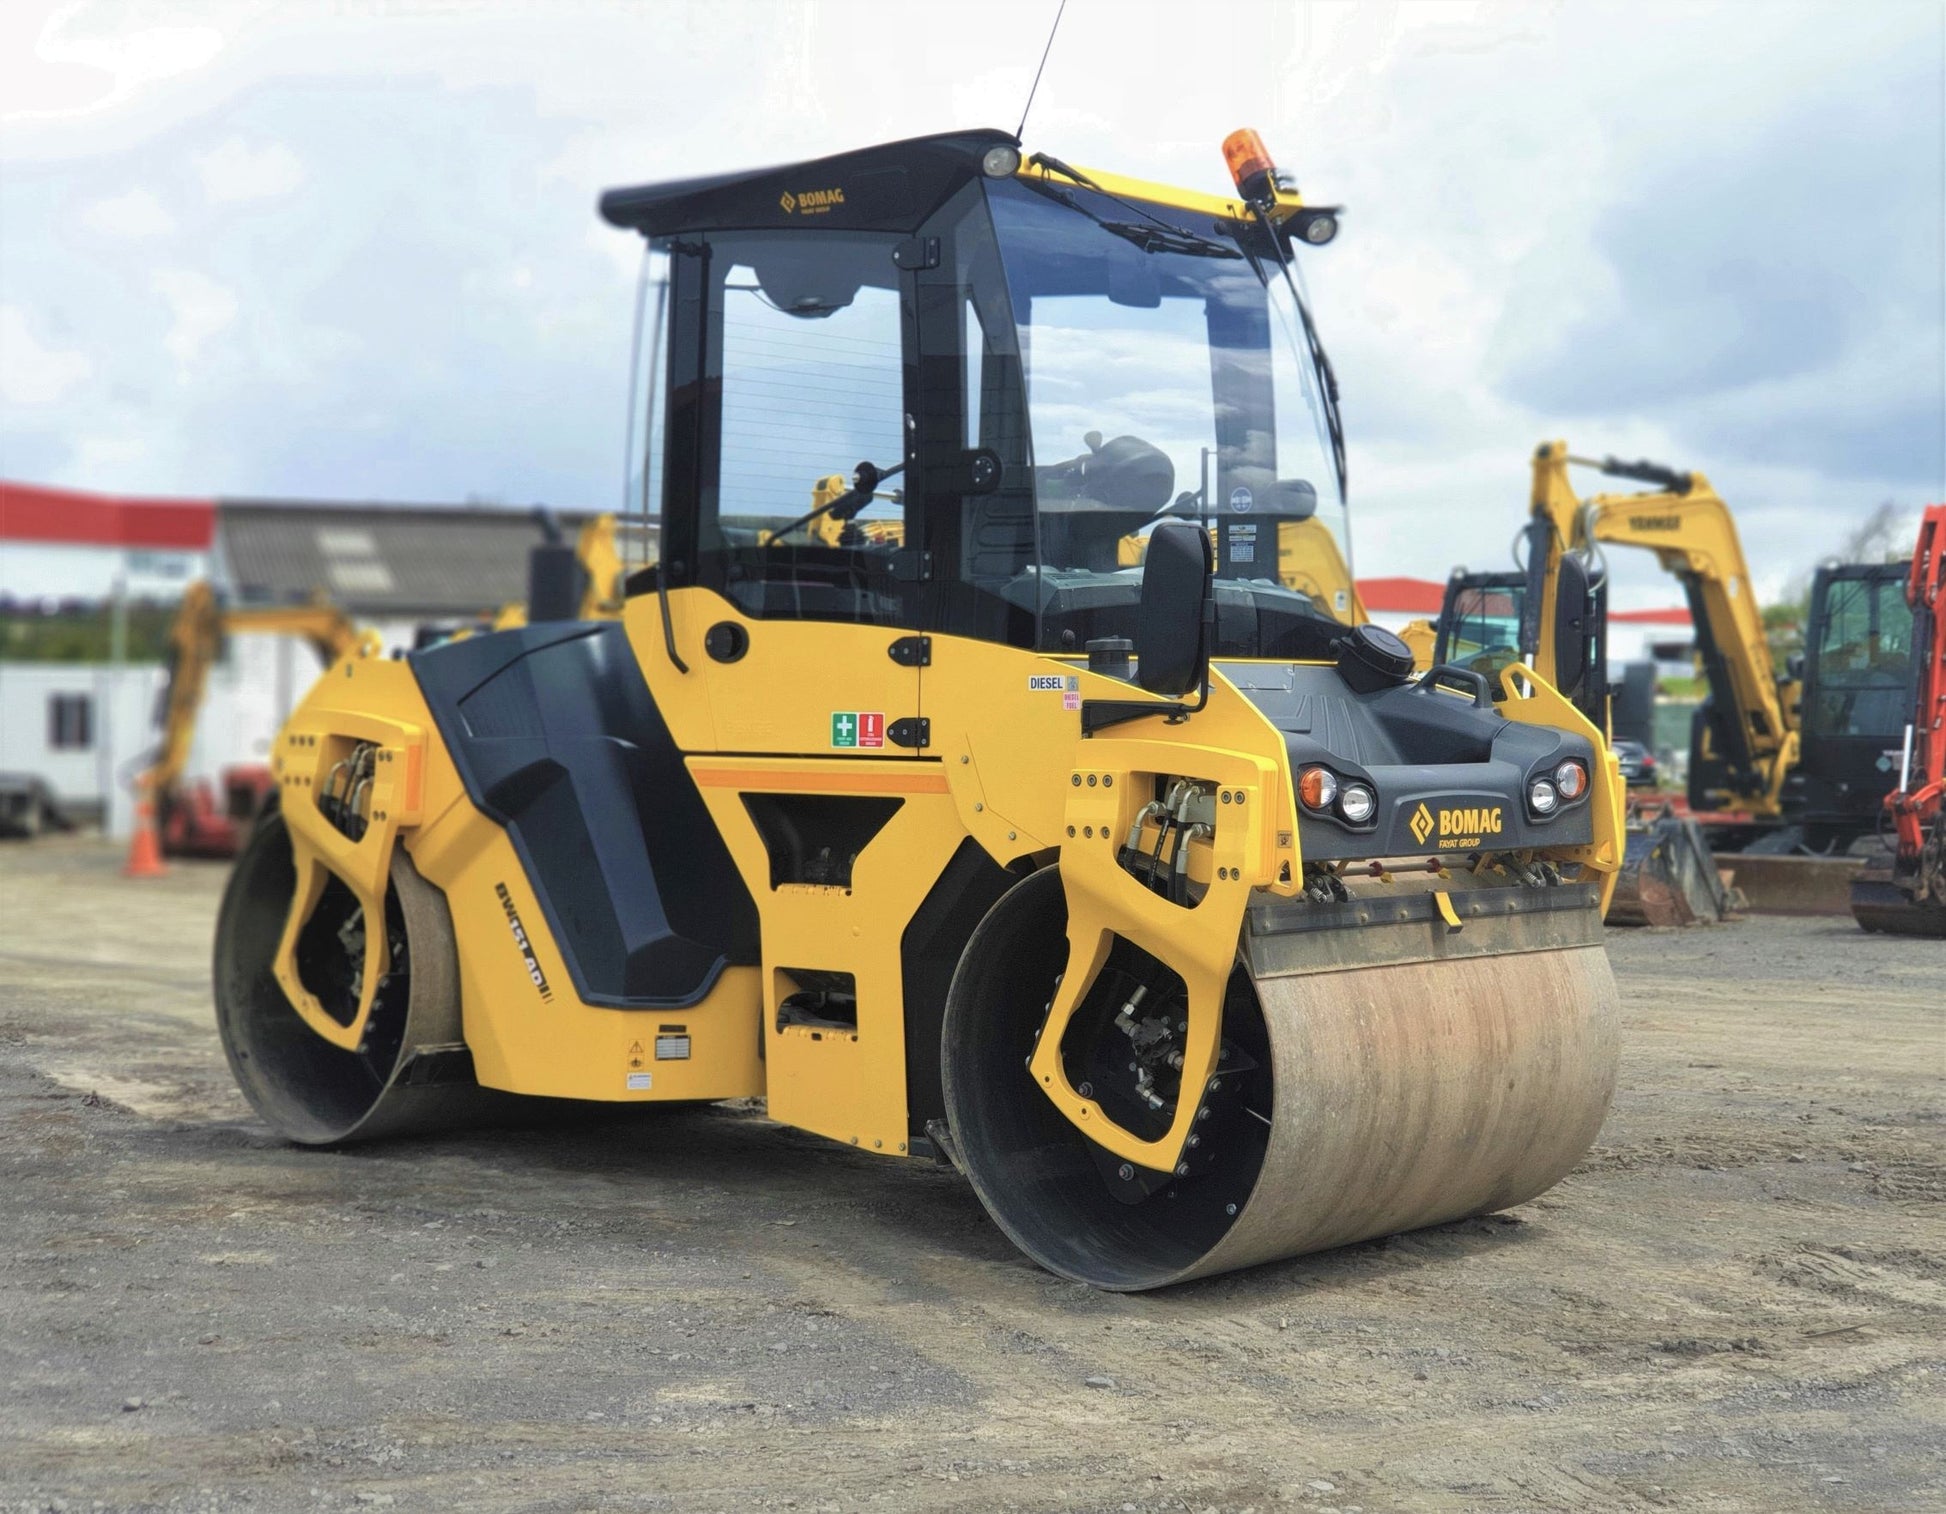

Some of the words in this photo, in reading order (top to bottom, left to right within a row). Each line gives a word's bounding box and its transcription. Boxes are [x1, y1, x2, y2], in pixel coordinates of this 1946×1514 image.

[798, 188, 845, 207] BOMAG
[1031, 677, 1063, 689] DIESEL
[1440, 807, 1502, 835] BOMAG
[1439, 839, 1458, 848] FAYAT
[1459, 838, 1481, 848] GROUP
